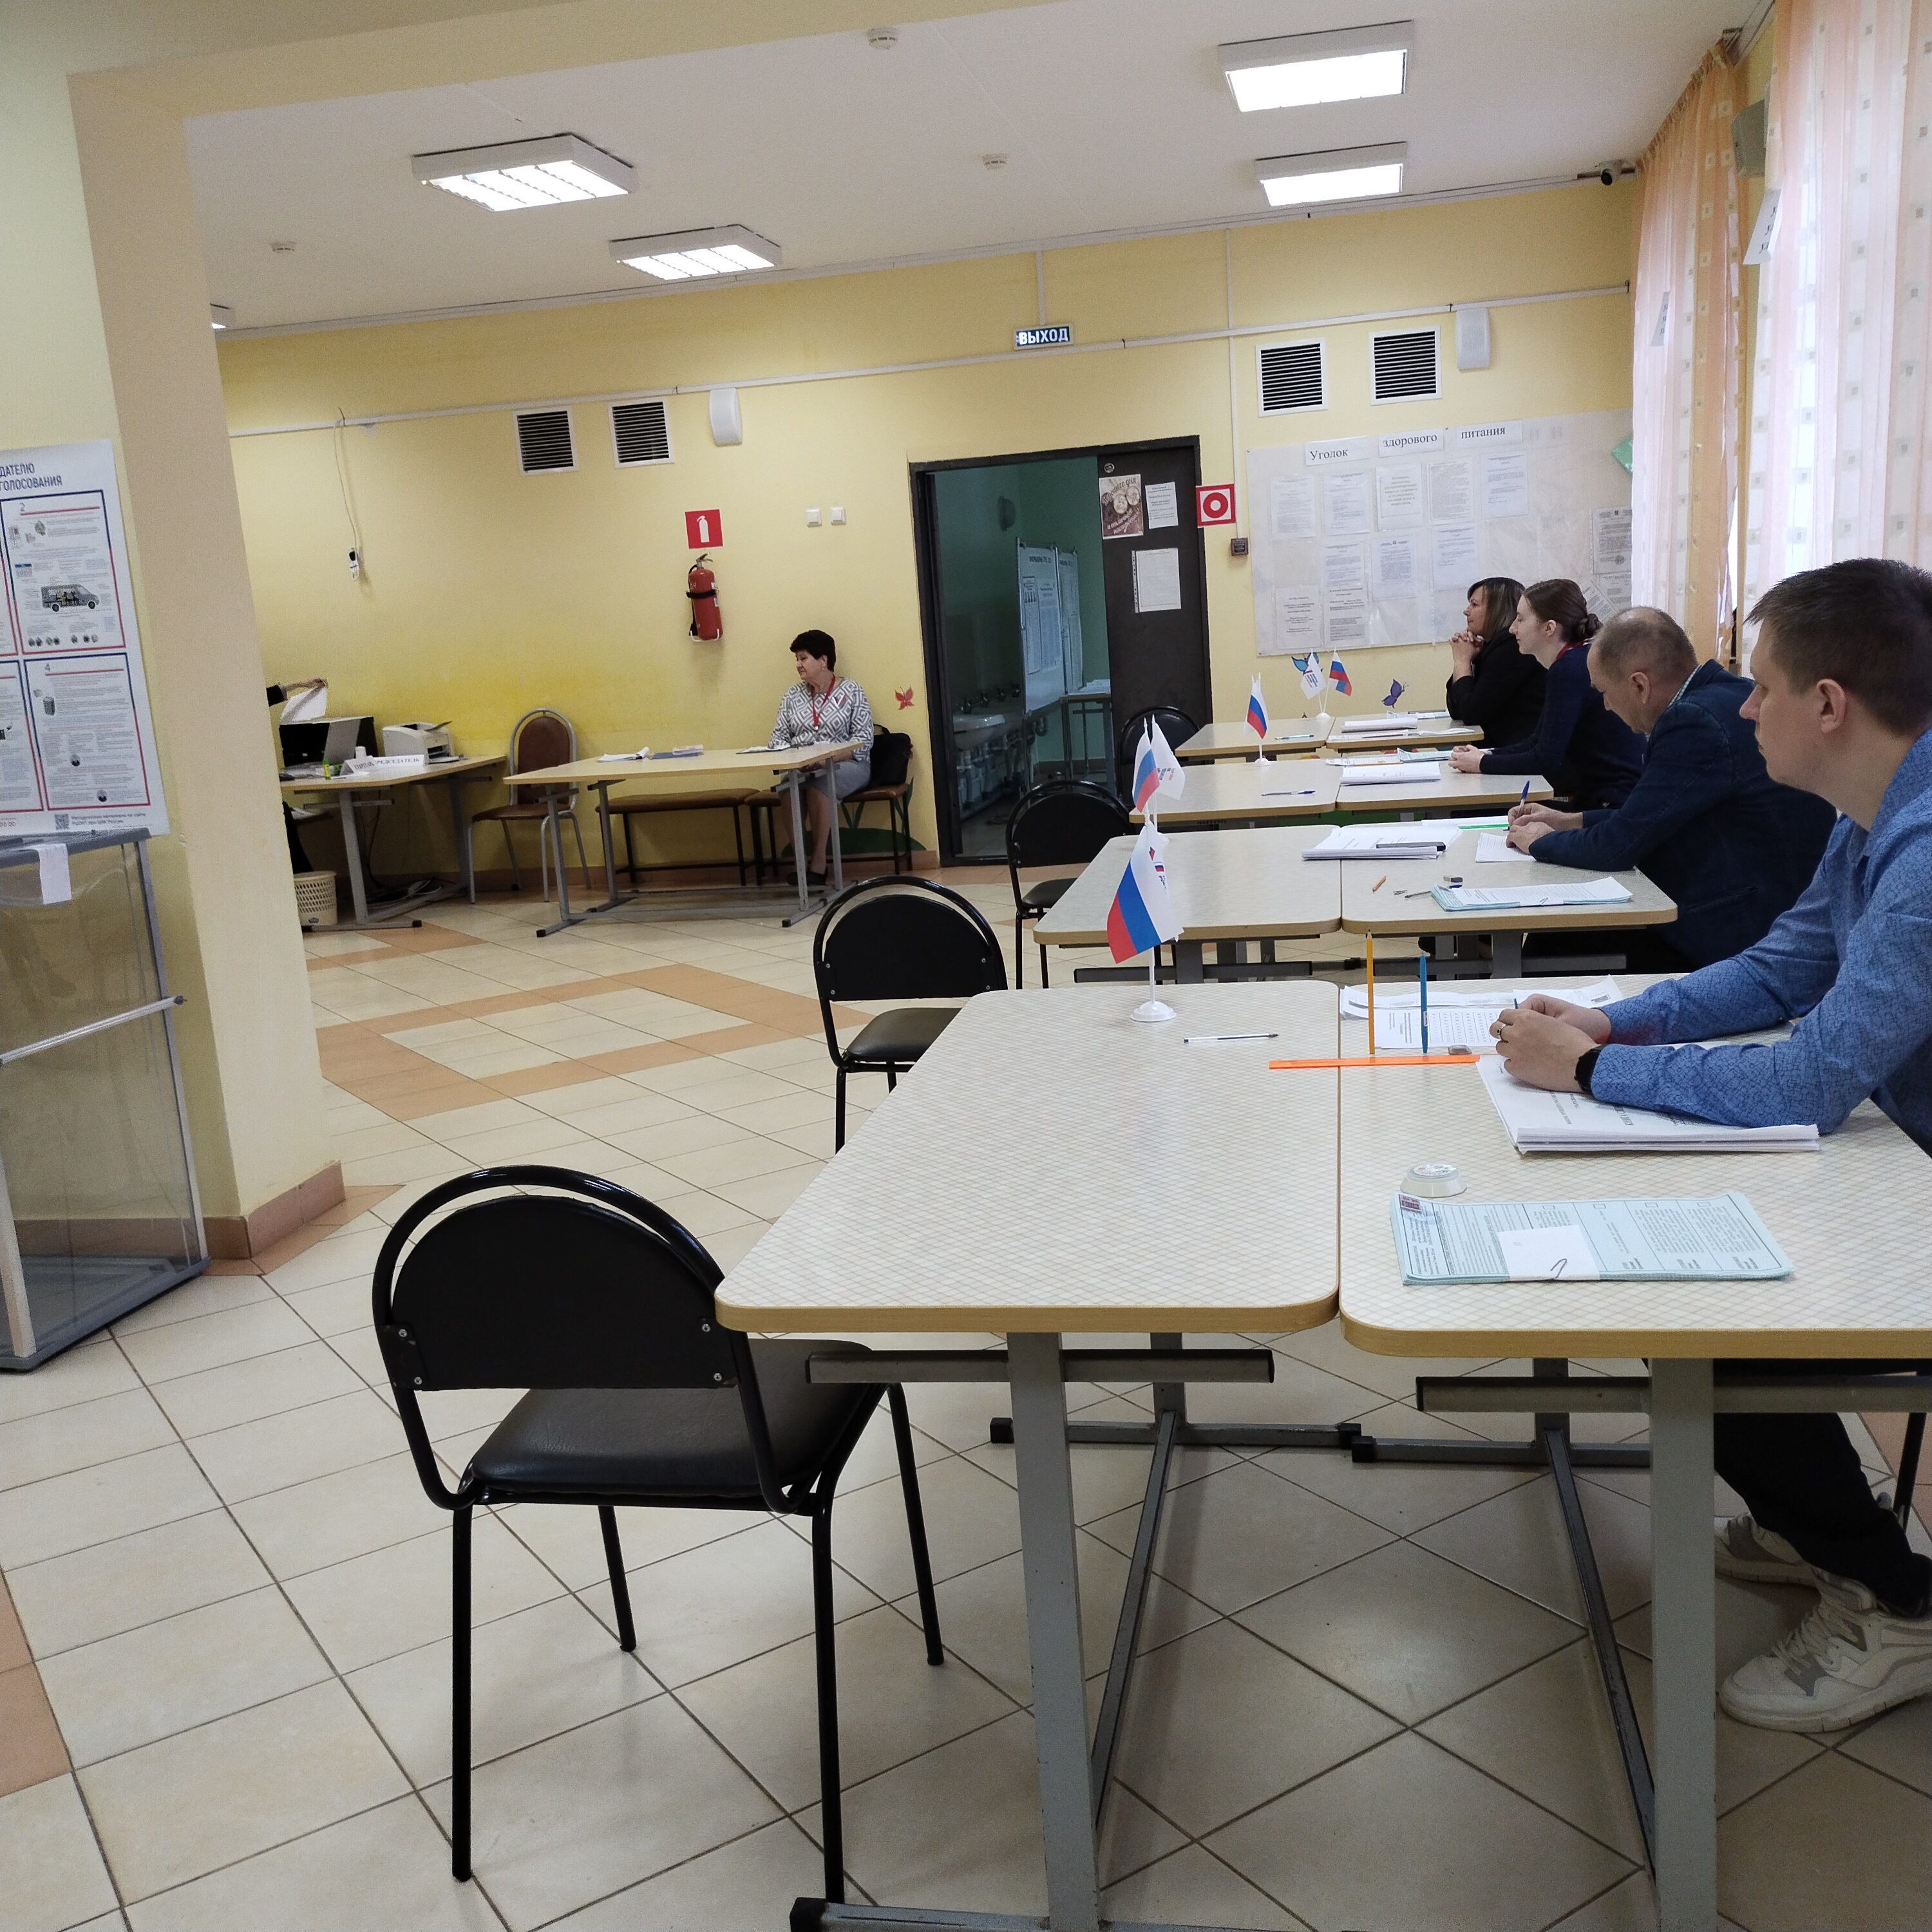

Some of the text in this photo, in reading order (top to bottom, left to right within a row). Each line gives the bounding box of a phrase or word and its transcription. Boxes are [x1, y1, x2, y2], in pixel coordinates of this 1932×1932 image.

[1018, 328, 1069, 345] ВЫХОД
[1309, 426, 1506, 460] Уголок здорового питания
[20, 503, 26, 511] 2
